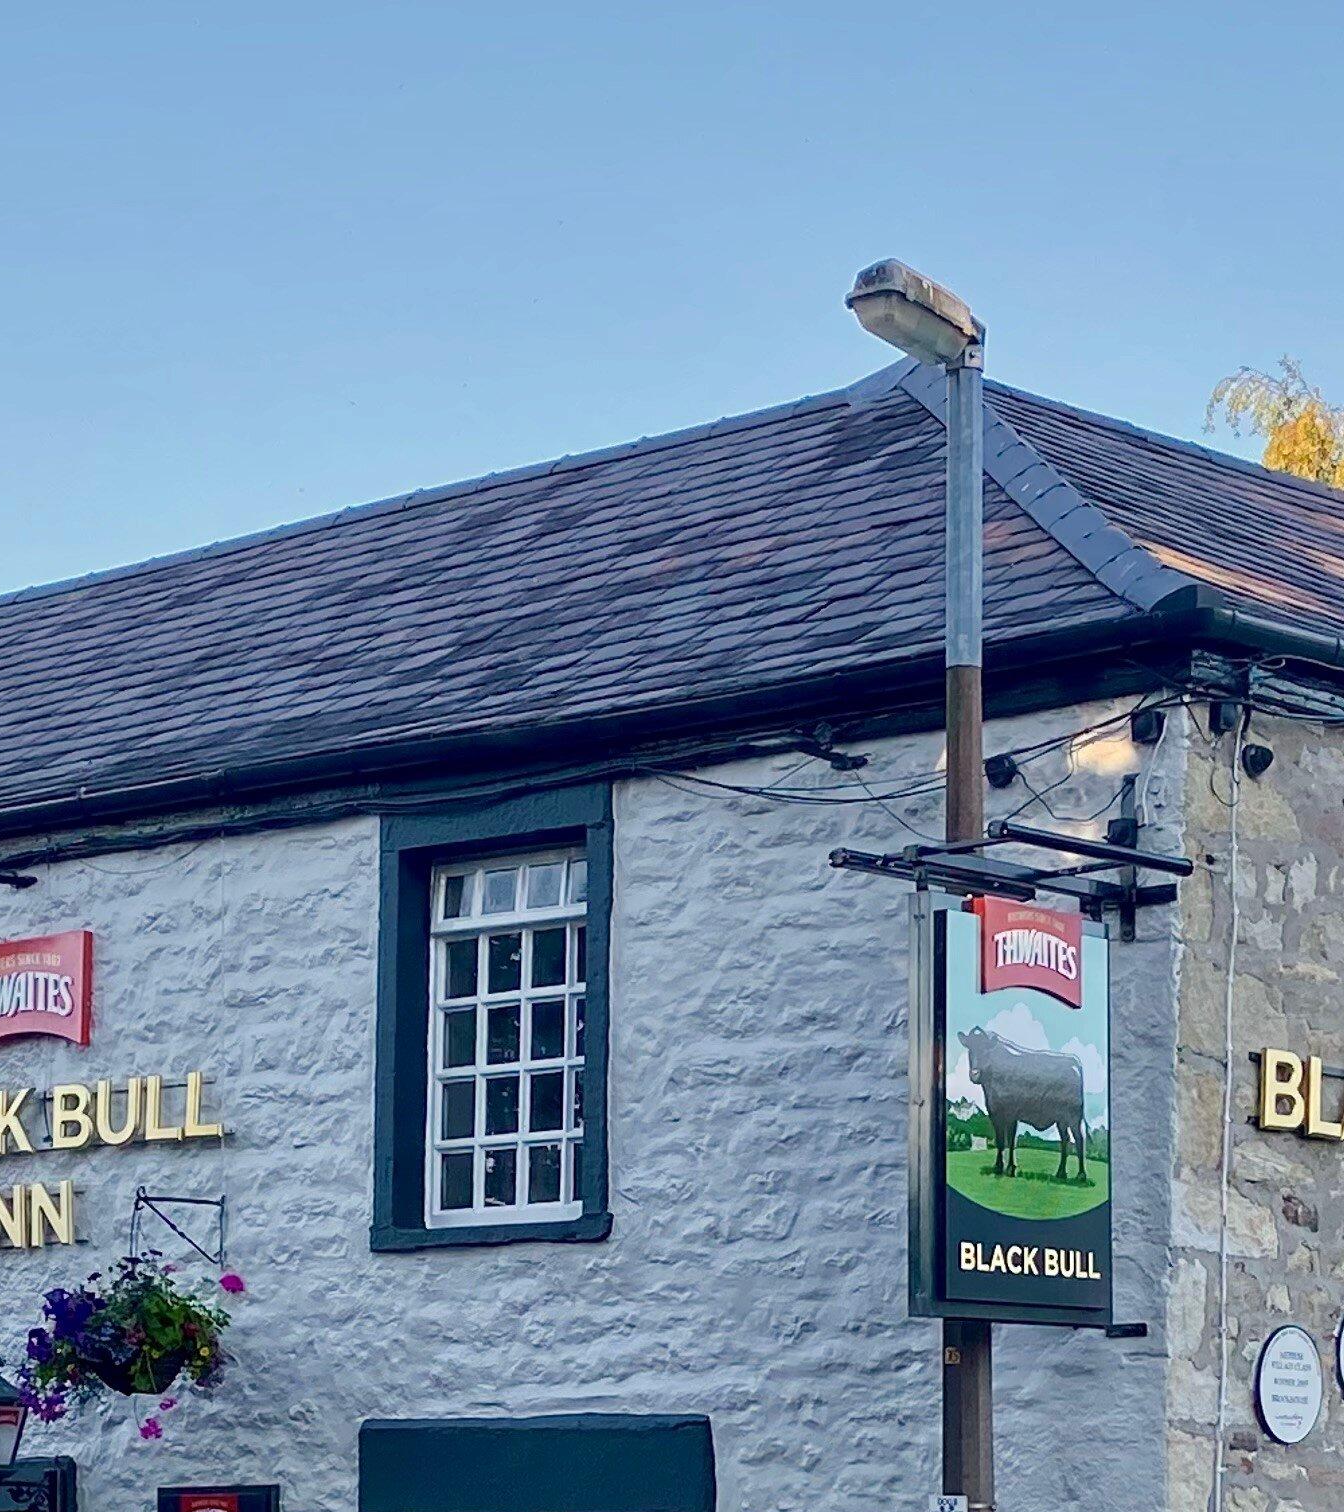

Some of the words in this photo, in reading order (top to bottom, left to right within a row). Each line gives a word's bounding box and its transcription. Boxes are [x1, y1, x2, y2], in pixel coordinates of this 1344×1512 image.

[994, 929, 1076, 980] THWAITES
[52, 1072, 225, 1150] BULL
[960, 1241, 1039, 1276] BLACK
[1044, 1248, 1102, 1280] BULL
